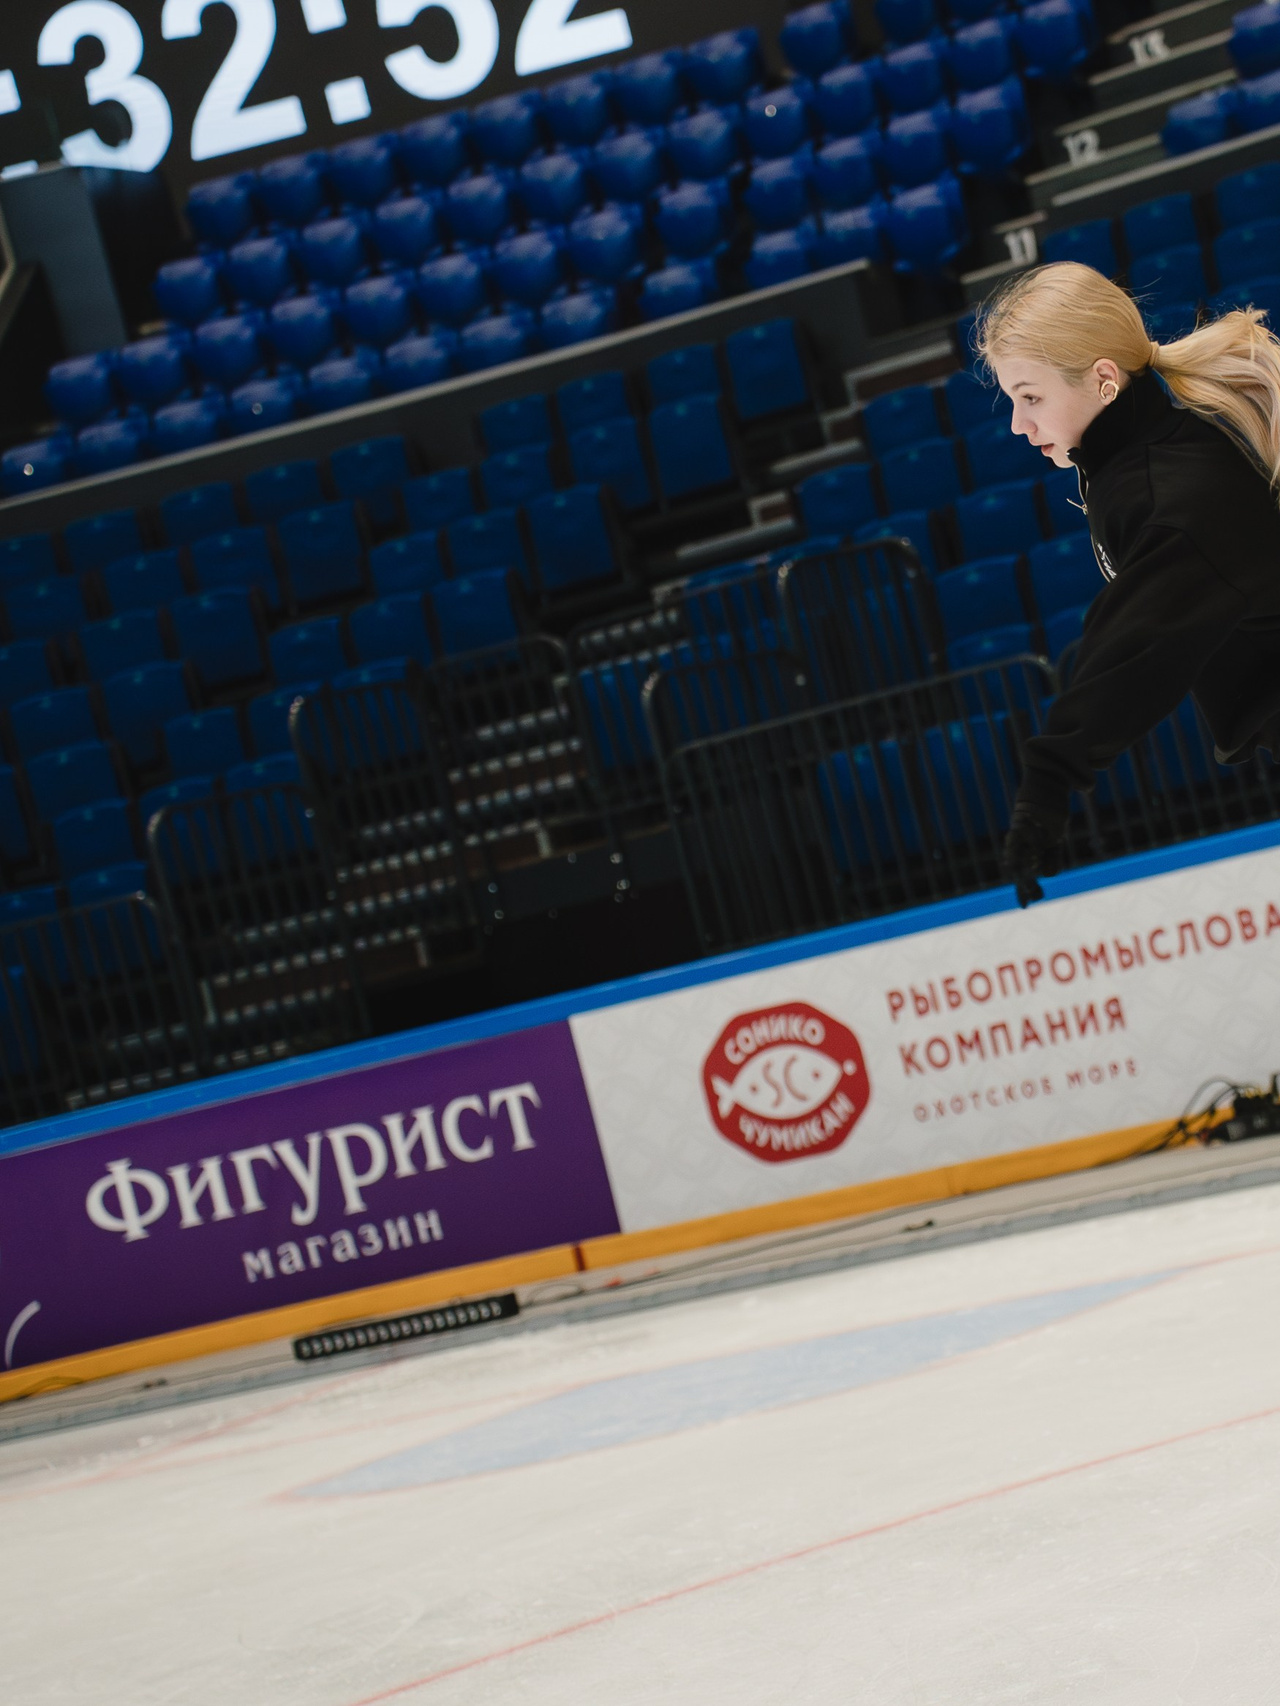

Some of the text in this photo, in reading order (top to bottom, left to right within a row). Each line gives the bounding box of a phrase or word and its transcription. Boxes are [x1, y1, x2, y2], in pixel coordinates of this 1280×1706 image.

[1063, 130, 1100, 165] 12
[724, 1013, 826, 1065] СОНИКО
[898, 996, 1128, 1077] КОМПАНИЯ
[738, 1091, 856, 1152] ЧУМИКАН
[913, 1057, 1140, 1123] ОХОТСКОЕ МОРЕ
[241, 1208, 445, 1283] магазин
